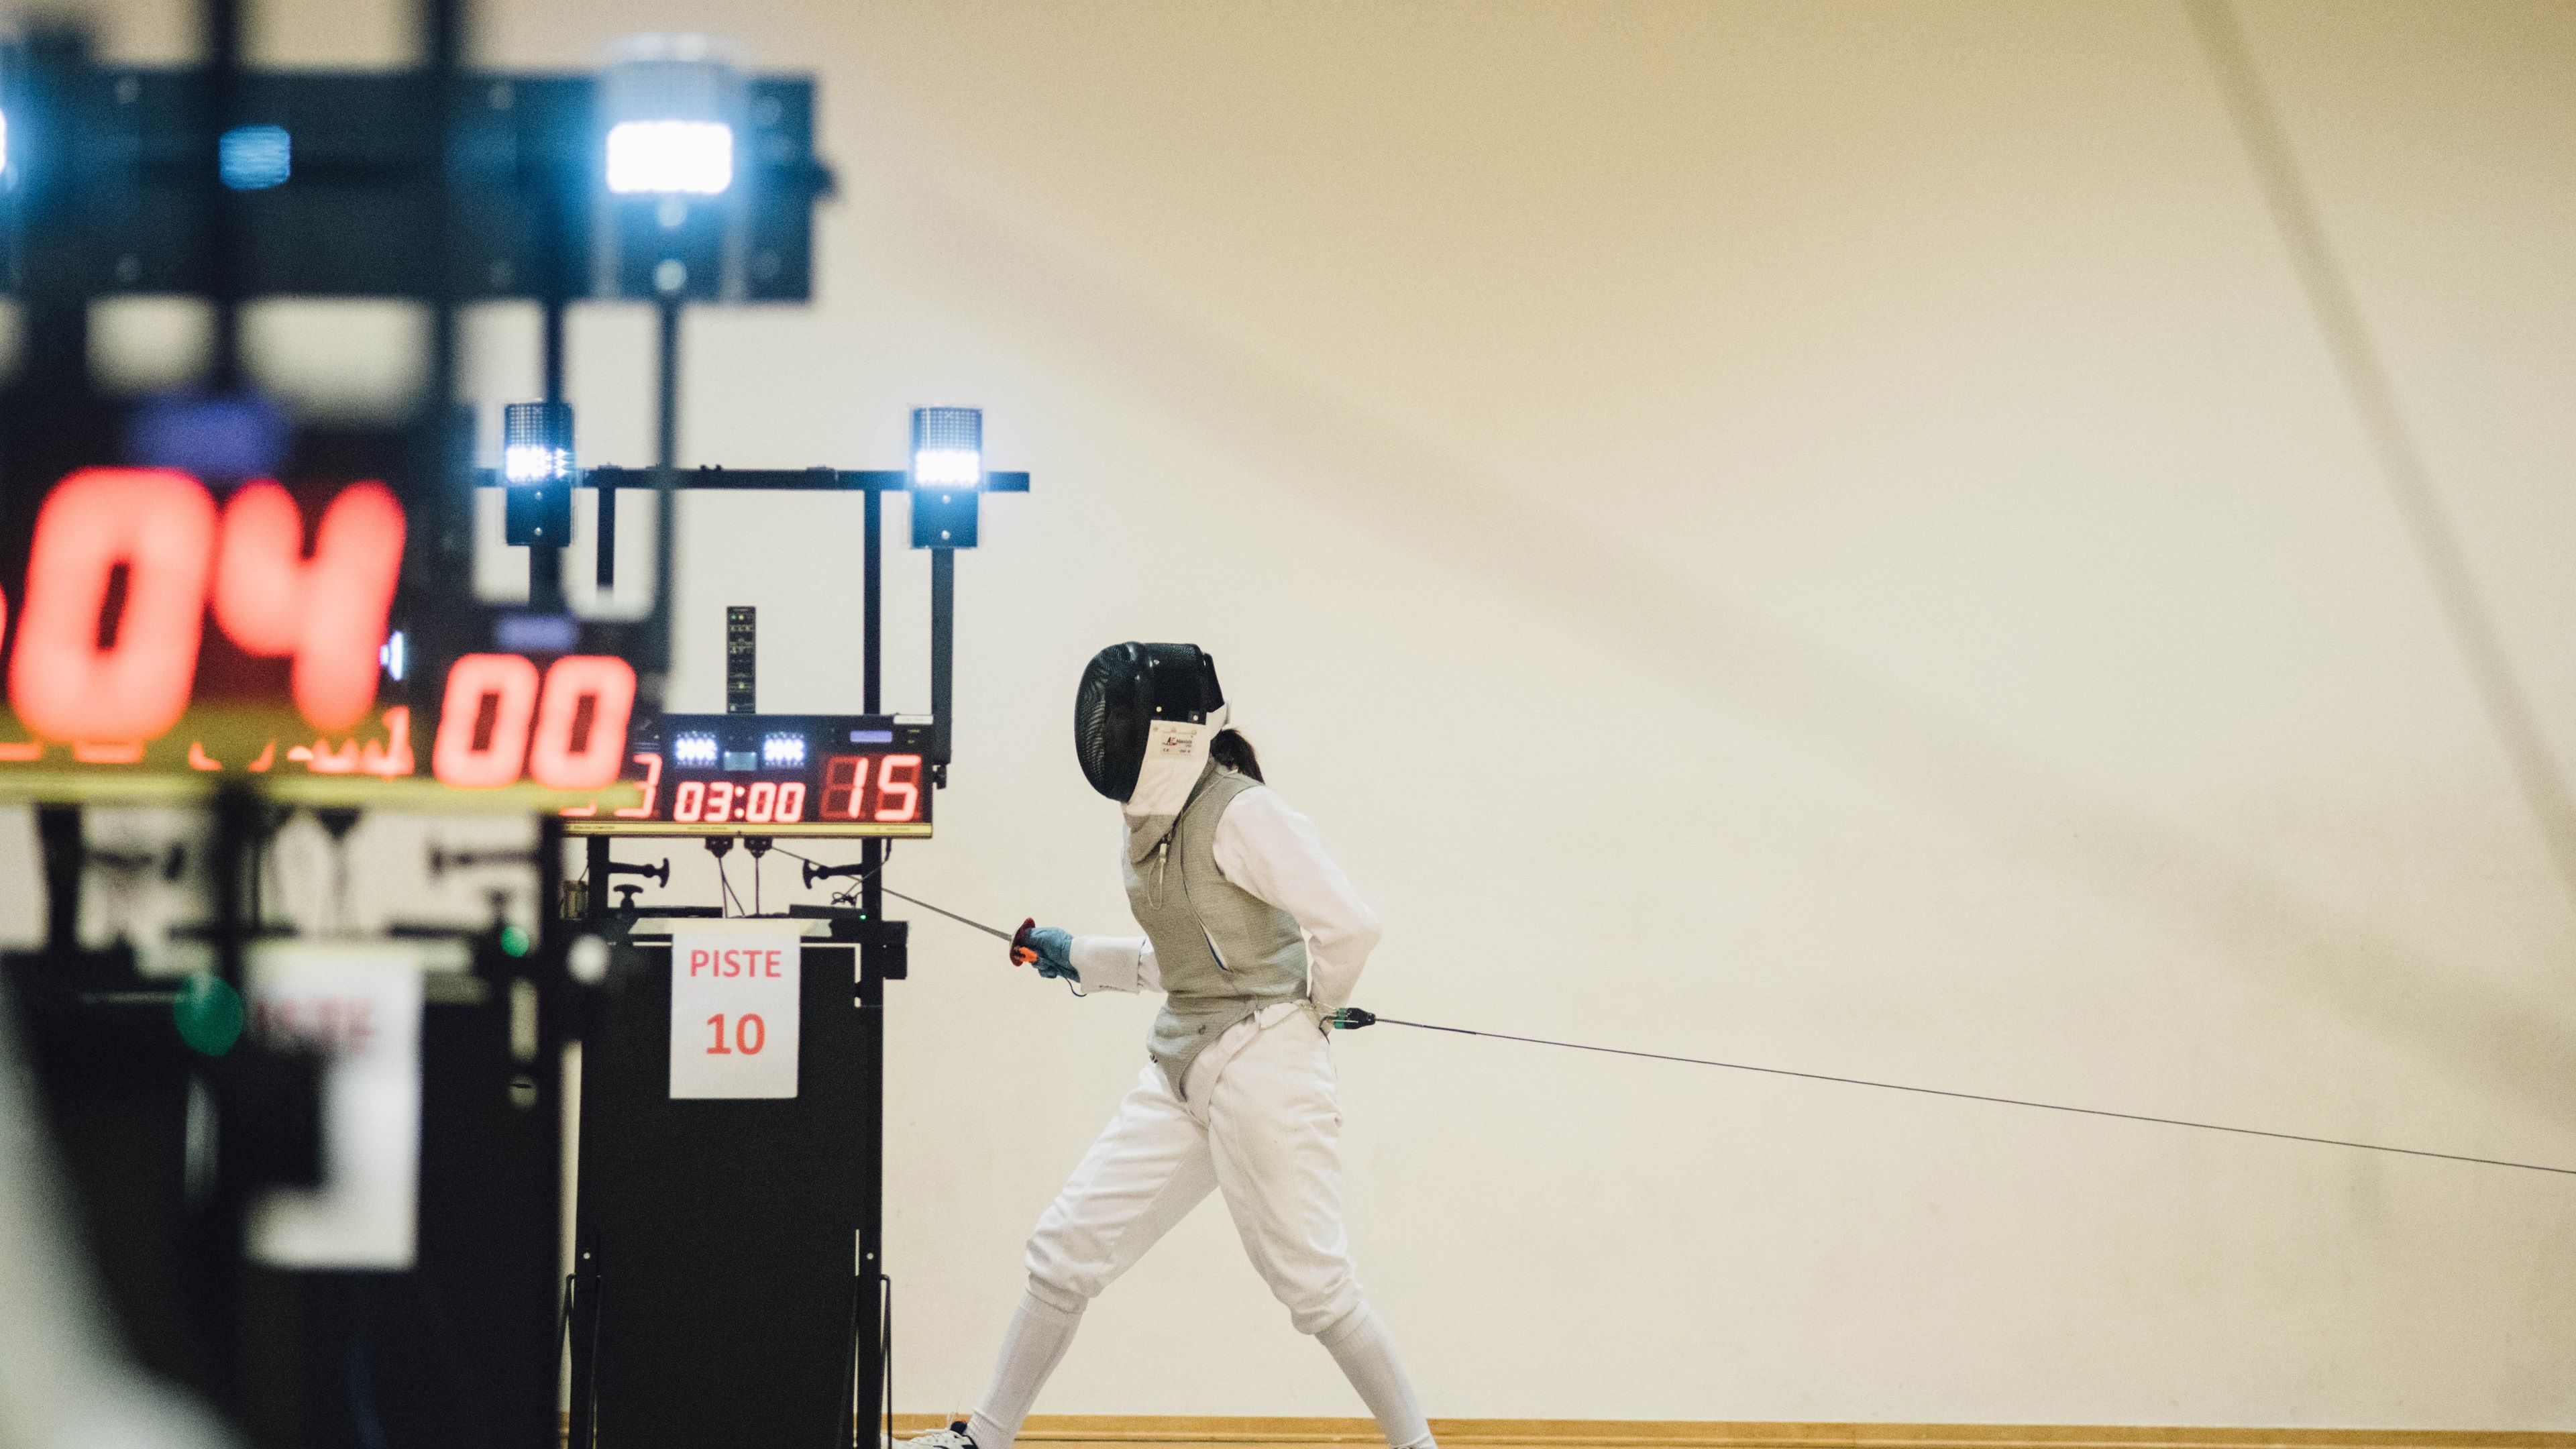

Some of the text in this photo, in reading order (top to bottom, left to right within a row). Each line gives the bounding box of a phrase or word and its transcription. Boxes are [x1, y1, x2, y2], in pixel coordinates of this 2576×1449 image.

[9, 467, 407, 743] 04
[433, 653, 637, 790] 00
[673, 781, 806, 824] 03:00
[847, 754, 922, 822] 15
[690, 949, 782, 977] PISTE
[706, 1013, 765, 1055] 10
